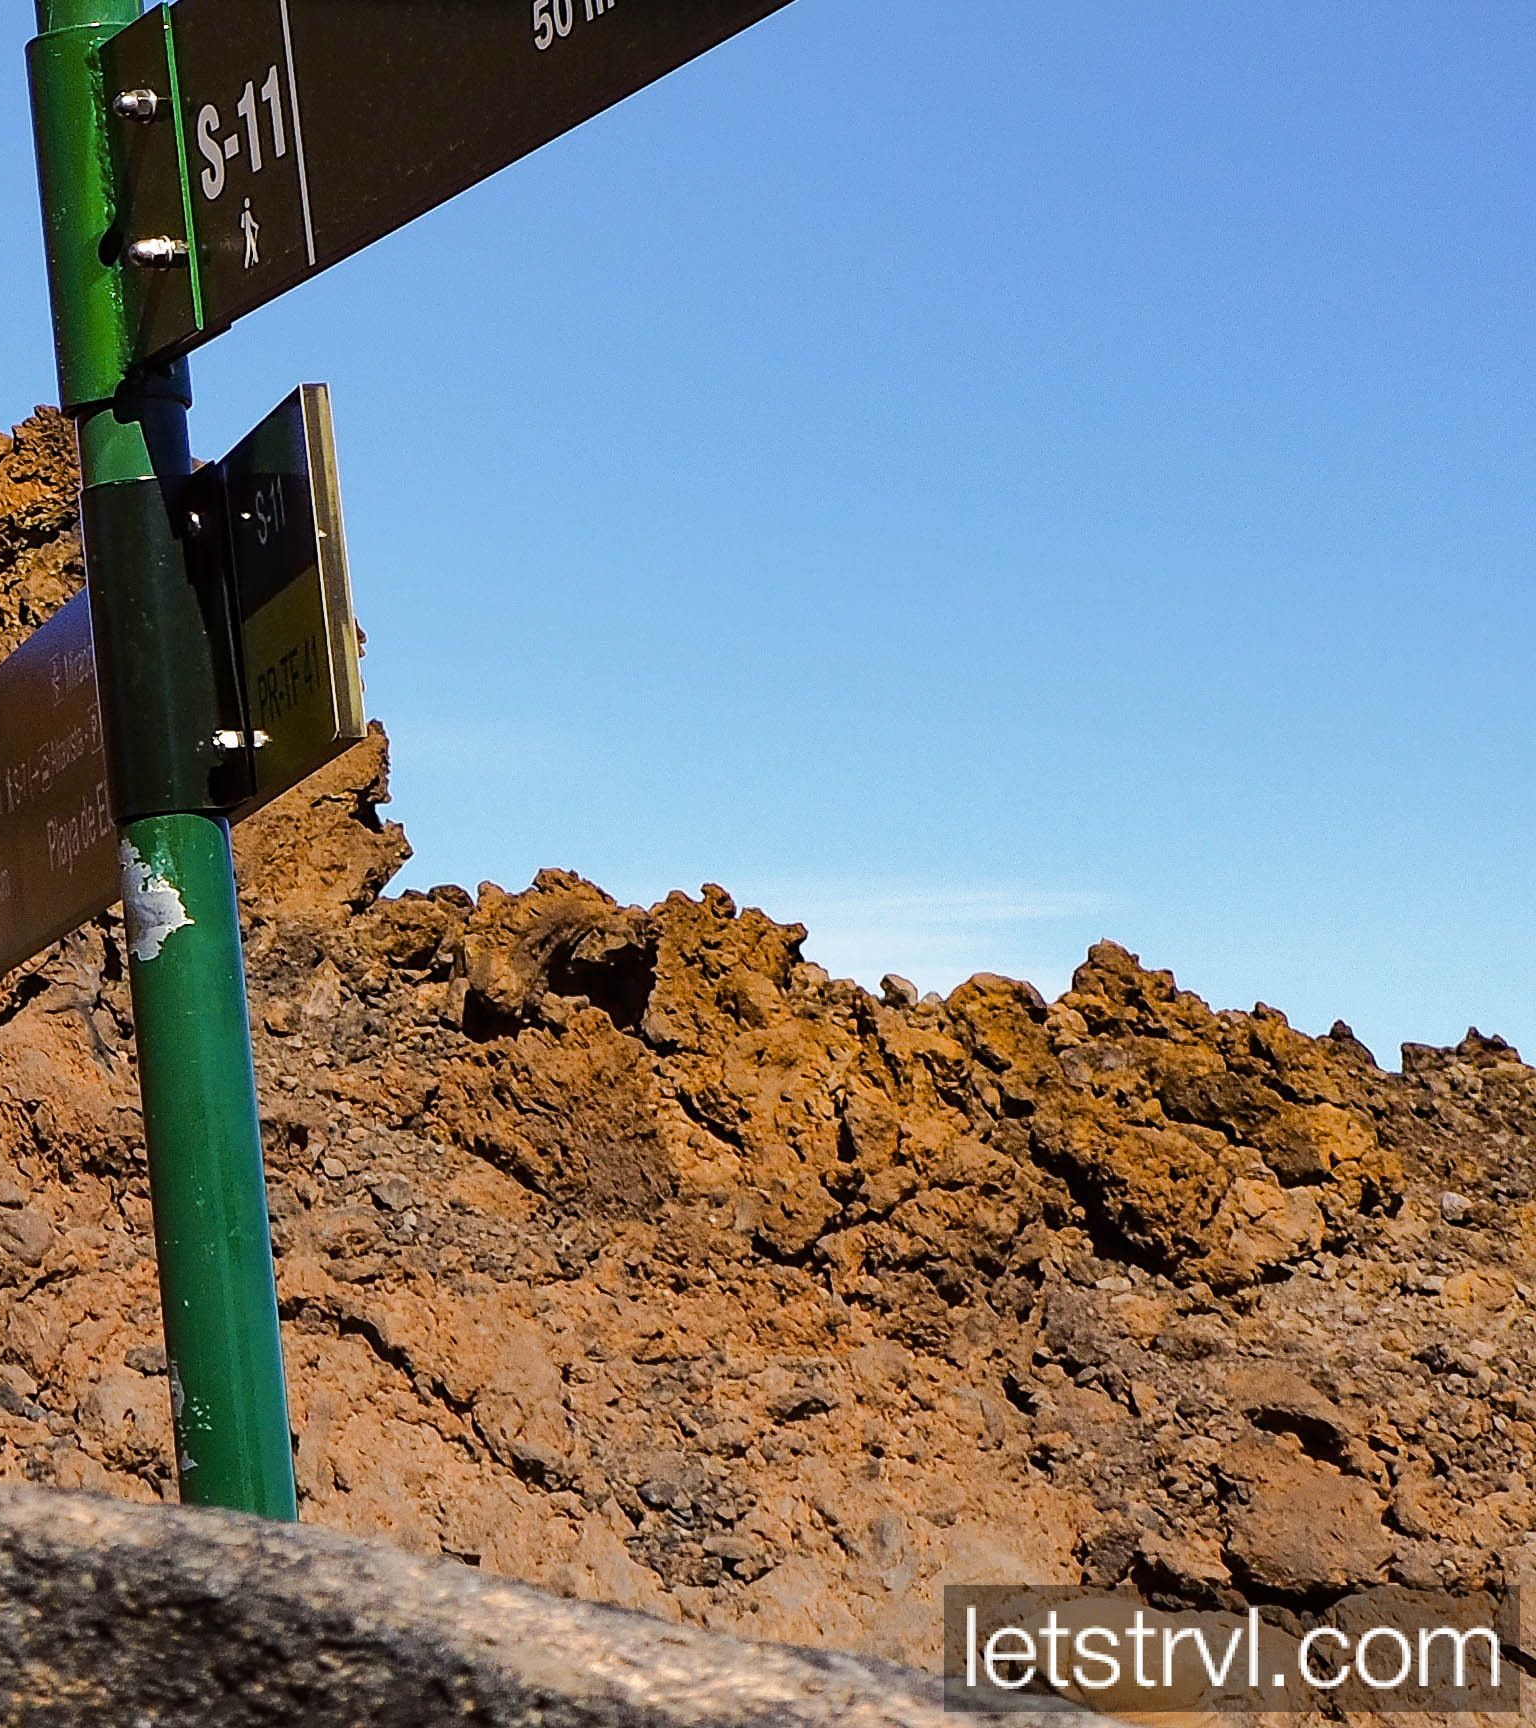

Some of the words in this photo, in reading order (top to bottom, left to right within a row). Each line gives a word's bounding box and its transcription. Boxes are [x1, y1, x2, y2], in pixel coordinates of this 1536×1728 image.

[196, 64, 288, 201] S-11
[255, 475, 286, 546] S-11
[47, 817, 80, 874] Playa
[80, 794, 96, 848] de
